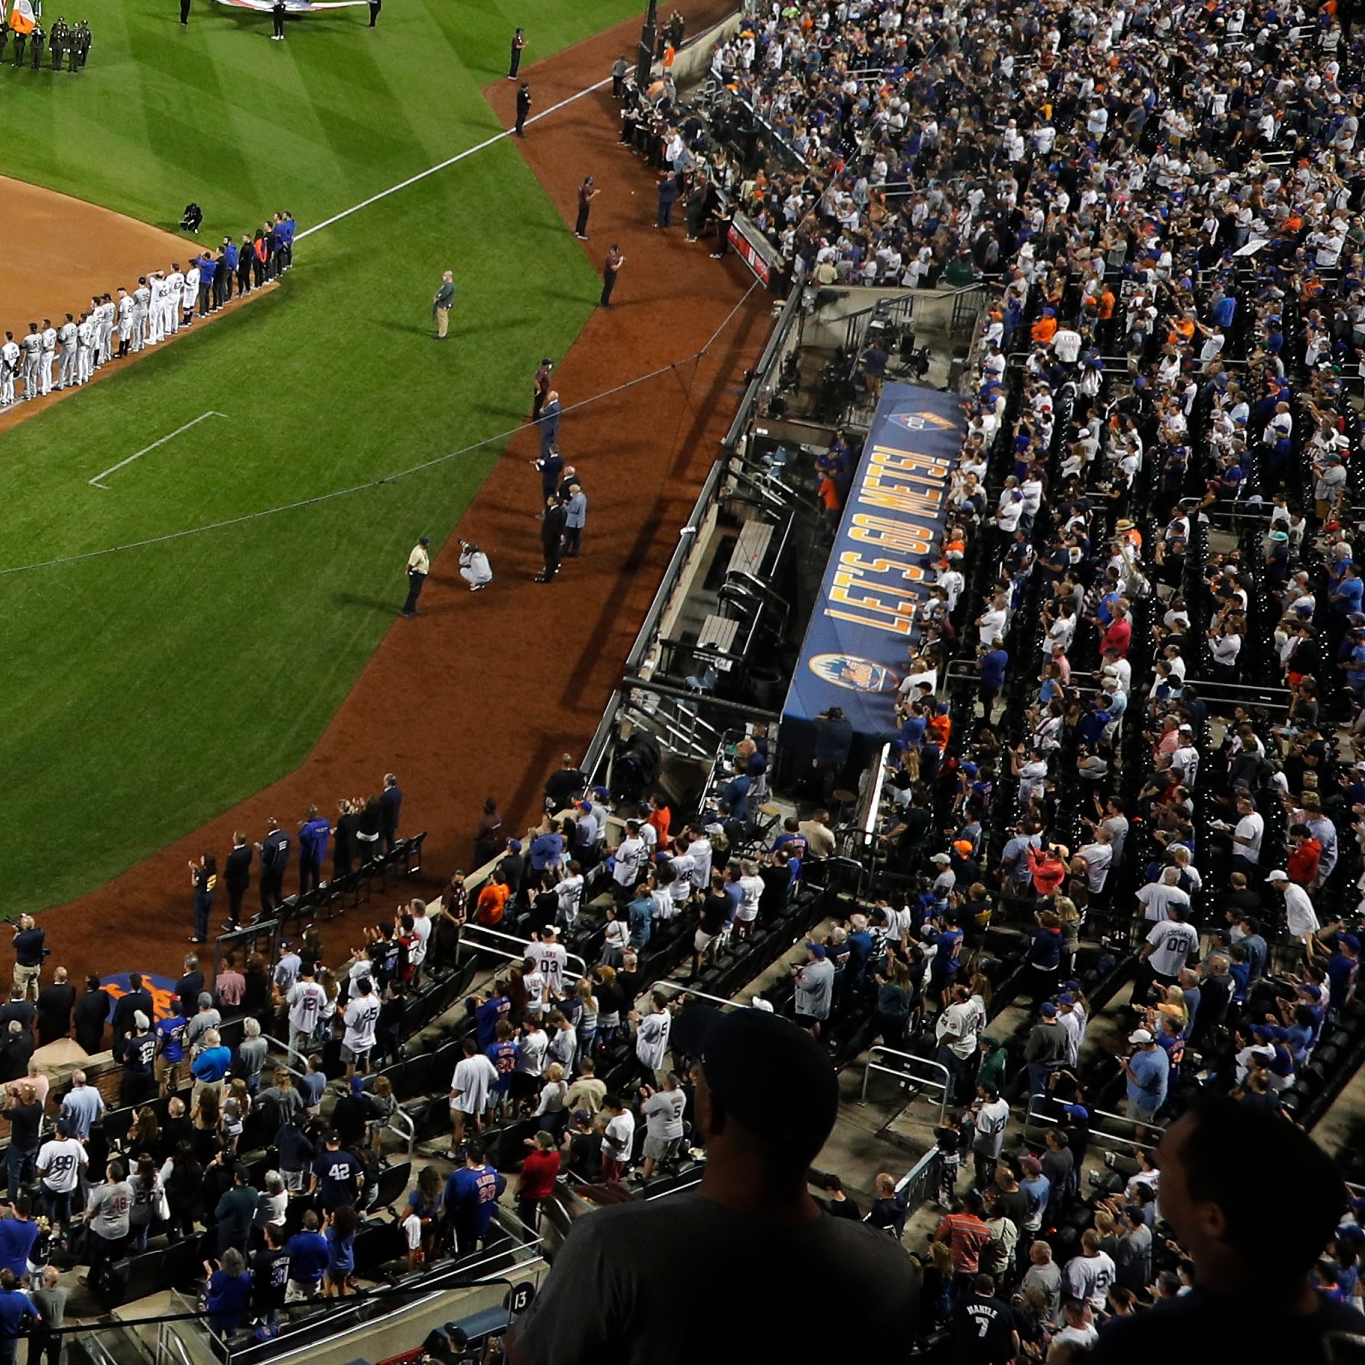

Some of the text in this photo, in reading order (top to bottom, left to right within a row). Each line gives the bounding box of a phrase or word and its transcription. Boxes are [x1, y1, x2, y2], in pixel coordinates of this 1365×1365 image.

[824, 444, 951, 635] LET'S GO METS!
[540, 960, 559, 974] 03
[328, 1162, 350, 1181] 42
[514, 1290, 528, 1310] 13
[966, 1305, 999, 1319] MANTLE
[975, 1316, 990, 1338] 7
